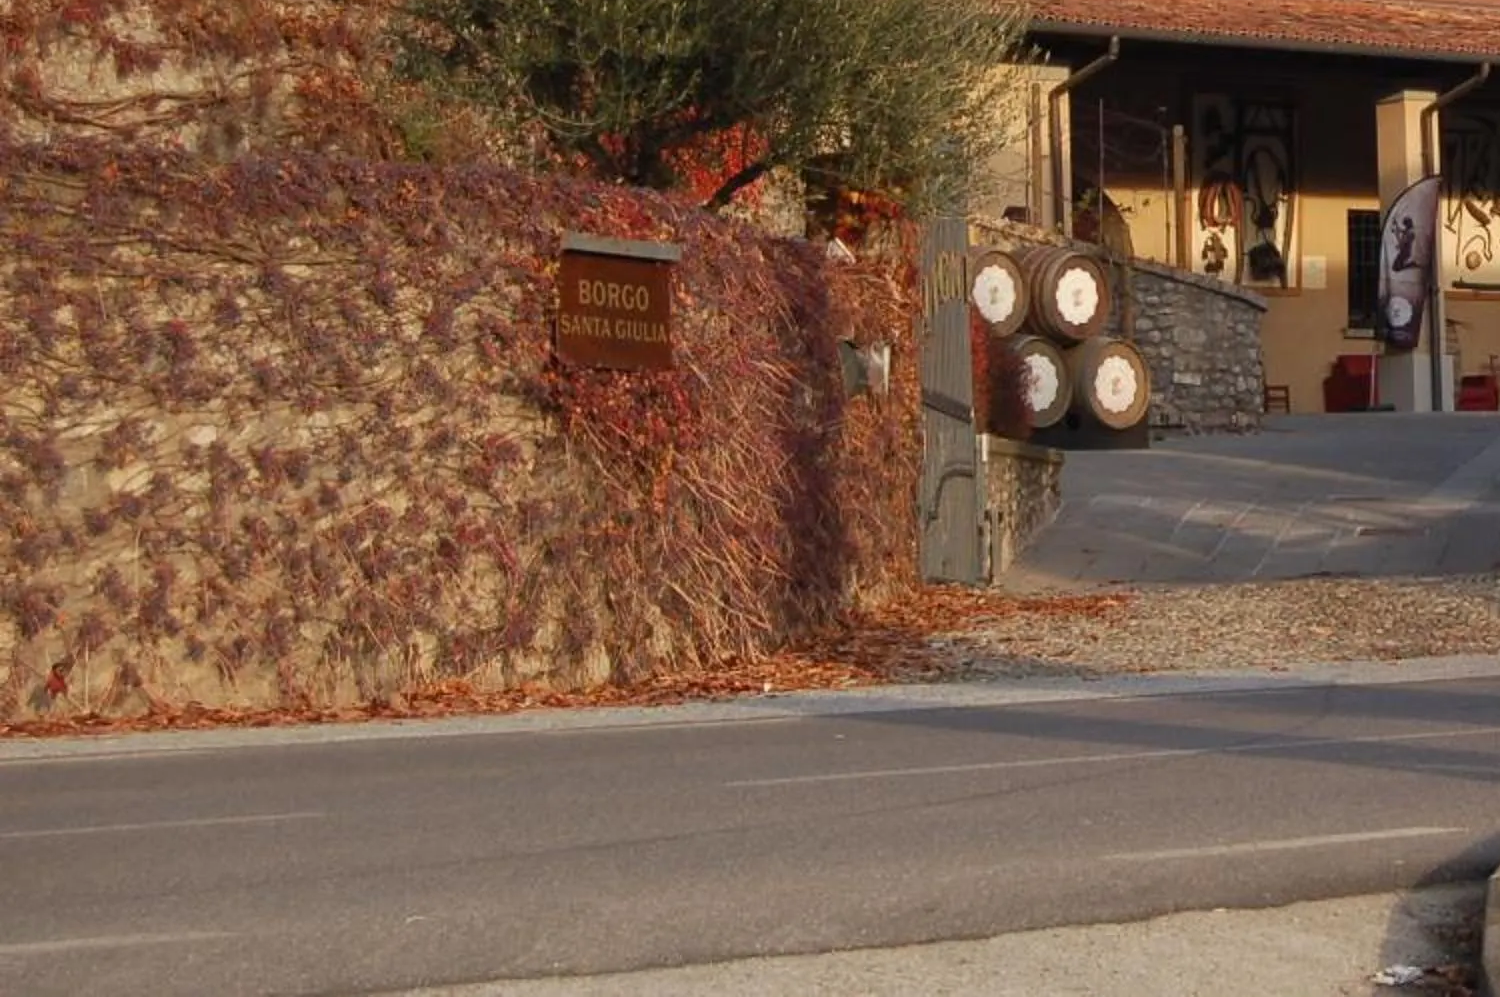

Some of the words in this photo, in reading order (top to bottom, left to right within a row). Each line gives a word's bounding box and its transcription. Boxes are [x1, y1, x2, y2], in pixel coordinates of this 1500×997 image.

[579, 279, 649, 312] BORGO
[560, 314, 612, 339] SANTA
[615, 318, 667, 343] GIULIA
